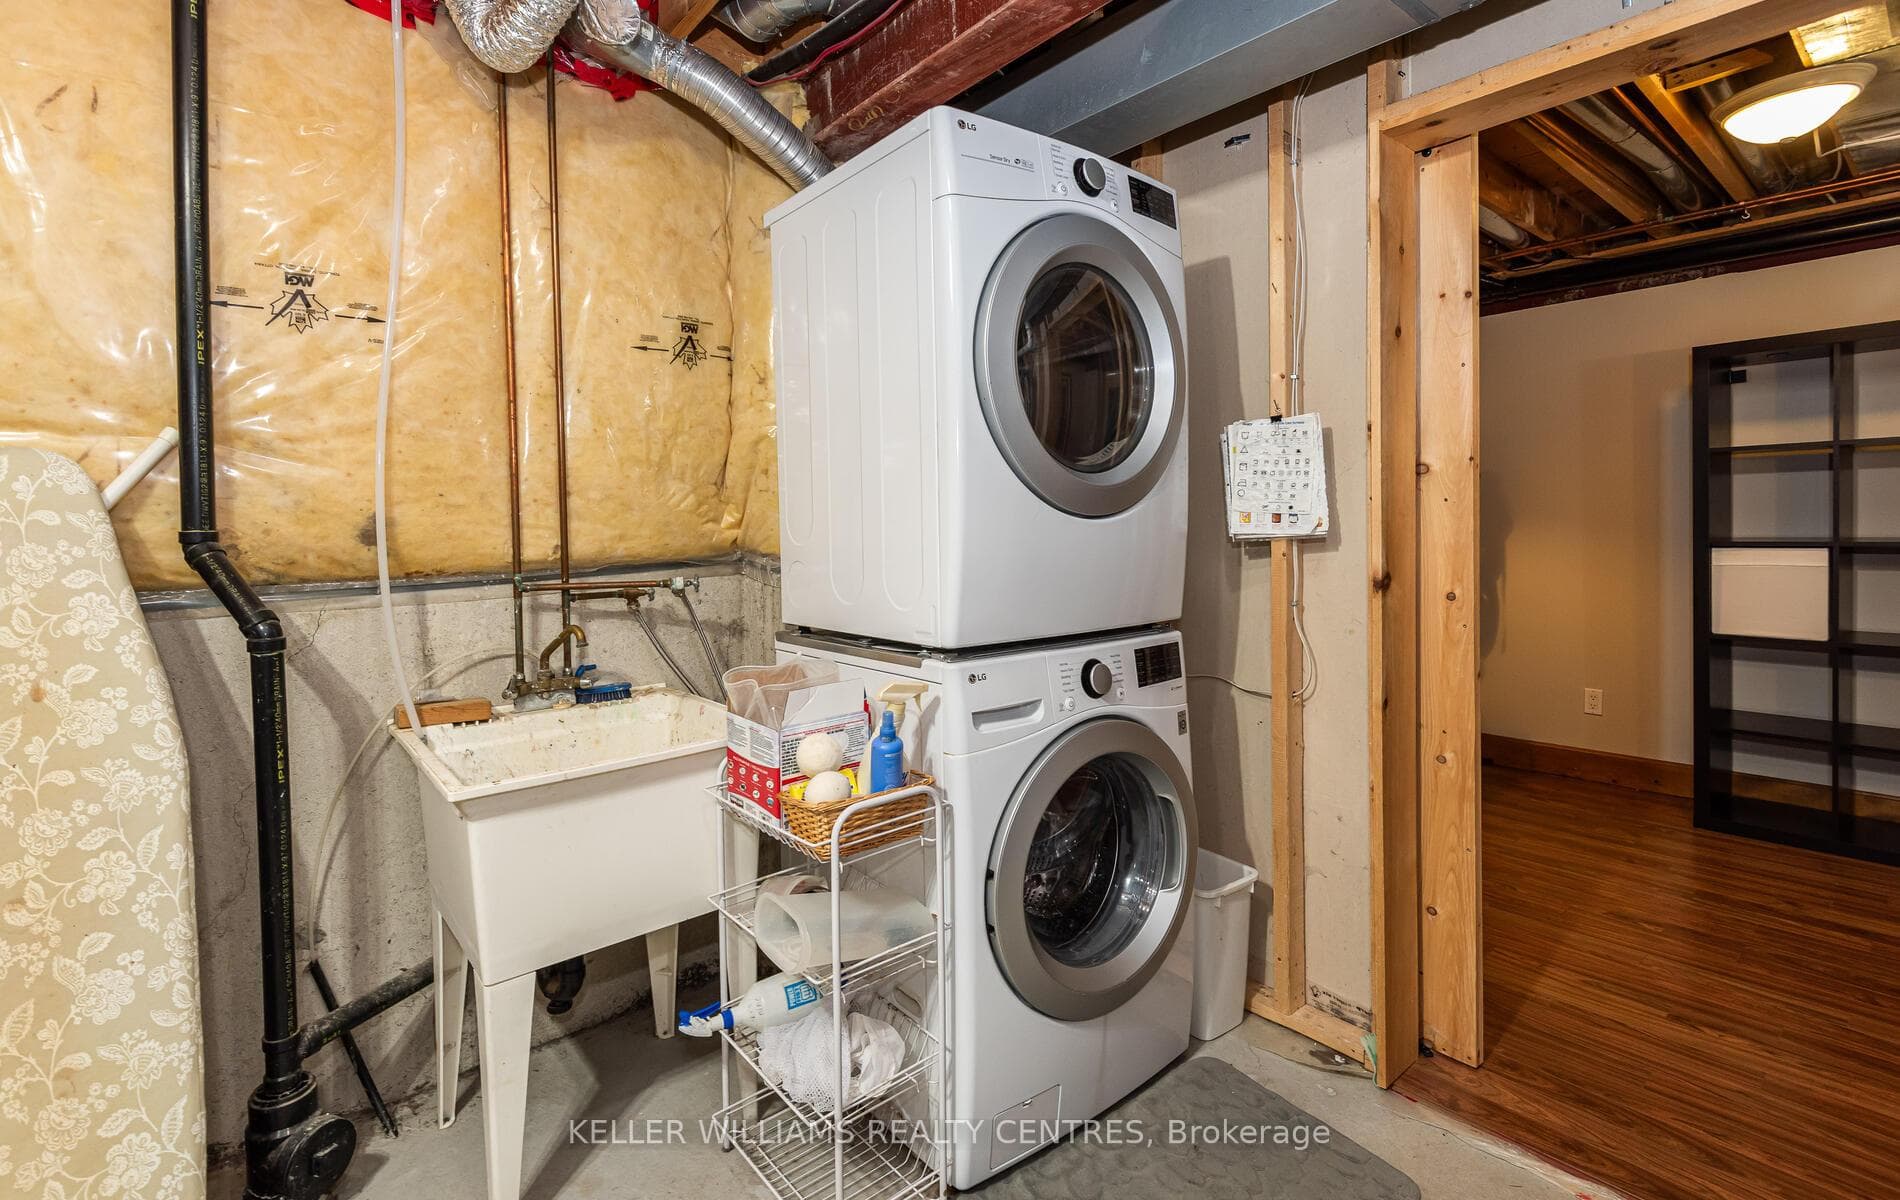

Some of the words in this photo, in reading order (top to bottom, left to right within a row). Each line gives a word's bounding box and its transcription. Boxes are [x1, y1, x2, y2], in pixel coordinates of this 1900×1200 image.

[967, 122, 977, 132] LG
[196, 329, 205, 365] IPEX
[977, 673, 987, 681] LG
[277, 748, 285, 784] IPEX
